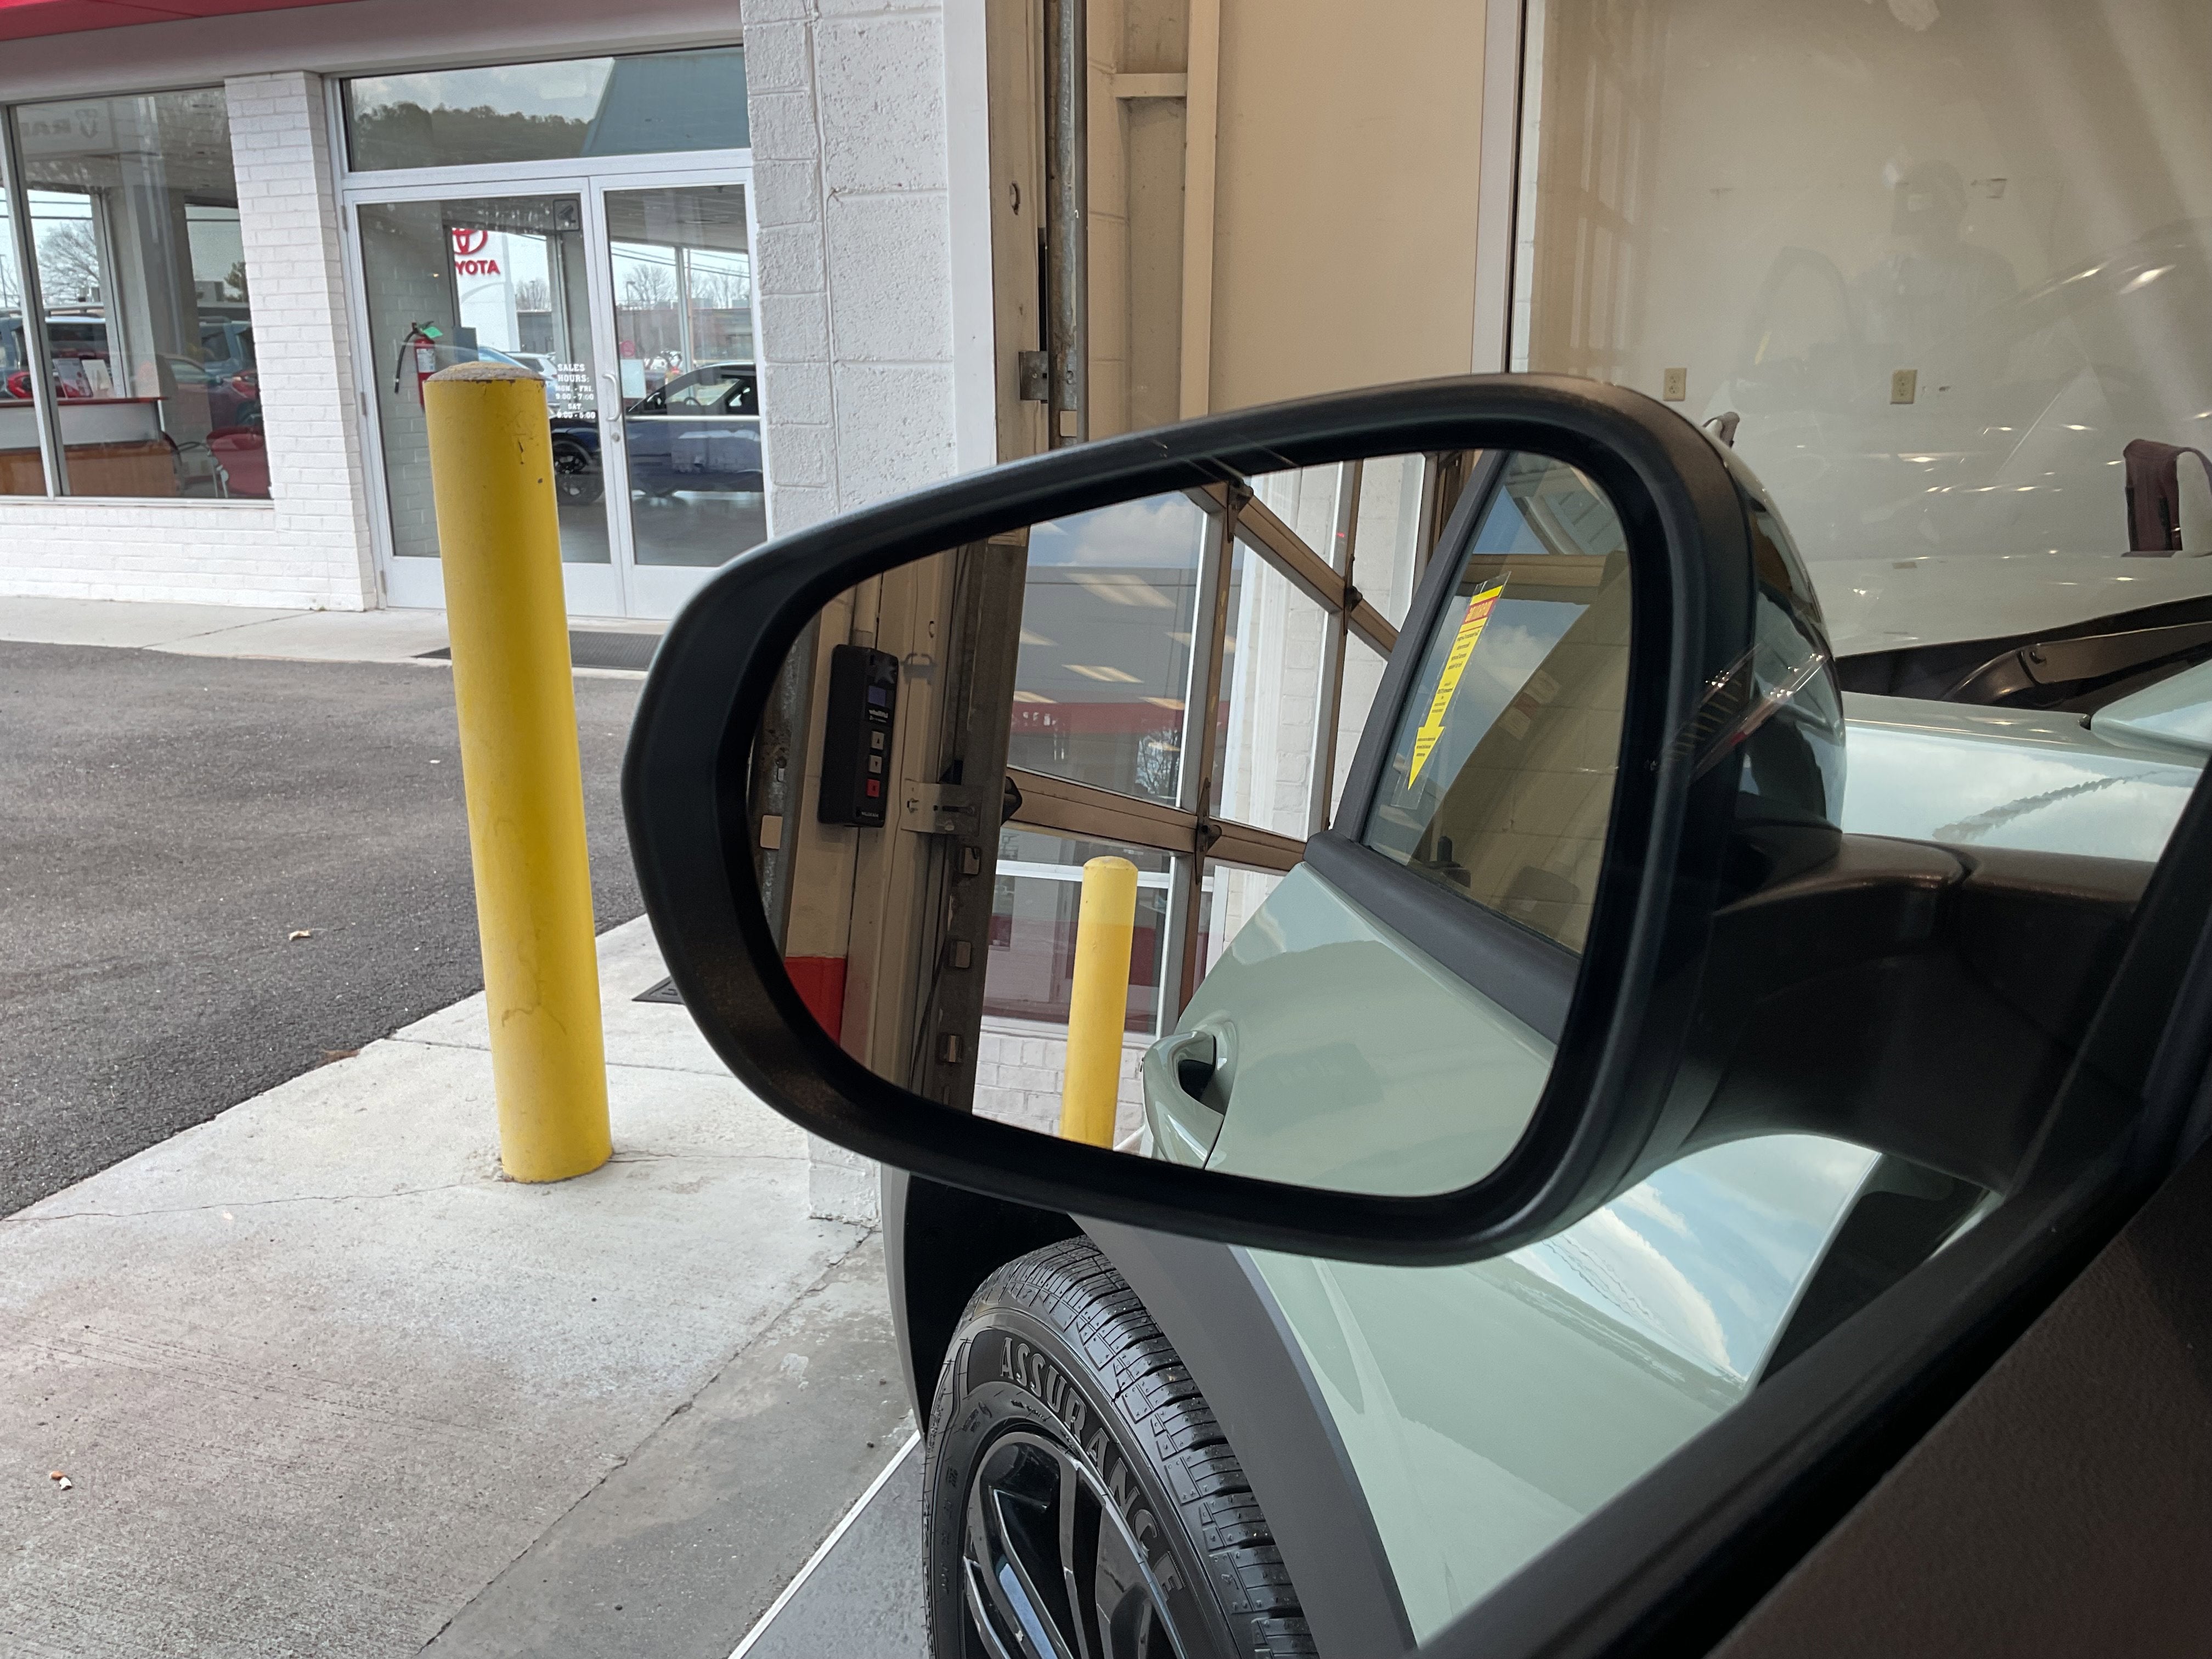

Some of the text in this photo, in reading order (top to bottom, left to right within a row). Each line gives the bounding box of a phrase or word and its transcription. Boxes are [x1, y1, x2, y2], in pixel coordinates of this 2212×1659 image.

[557, 363, 585, 372] SALES
[557, 374, 590, 383] HOURS:
[1000, 1336, 1186, 1601] ASSURANCE
